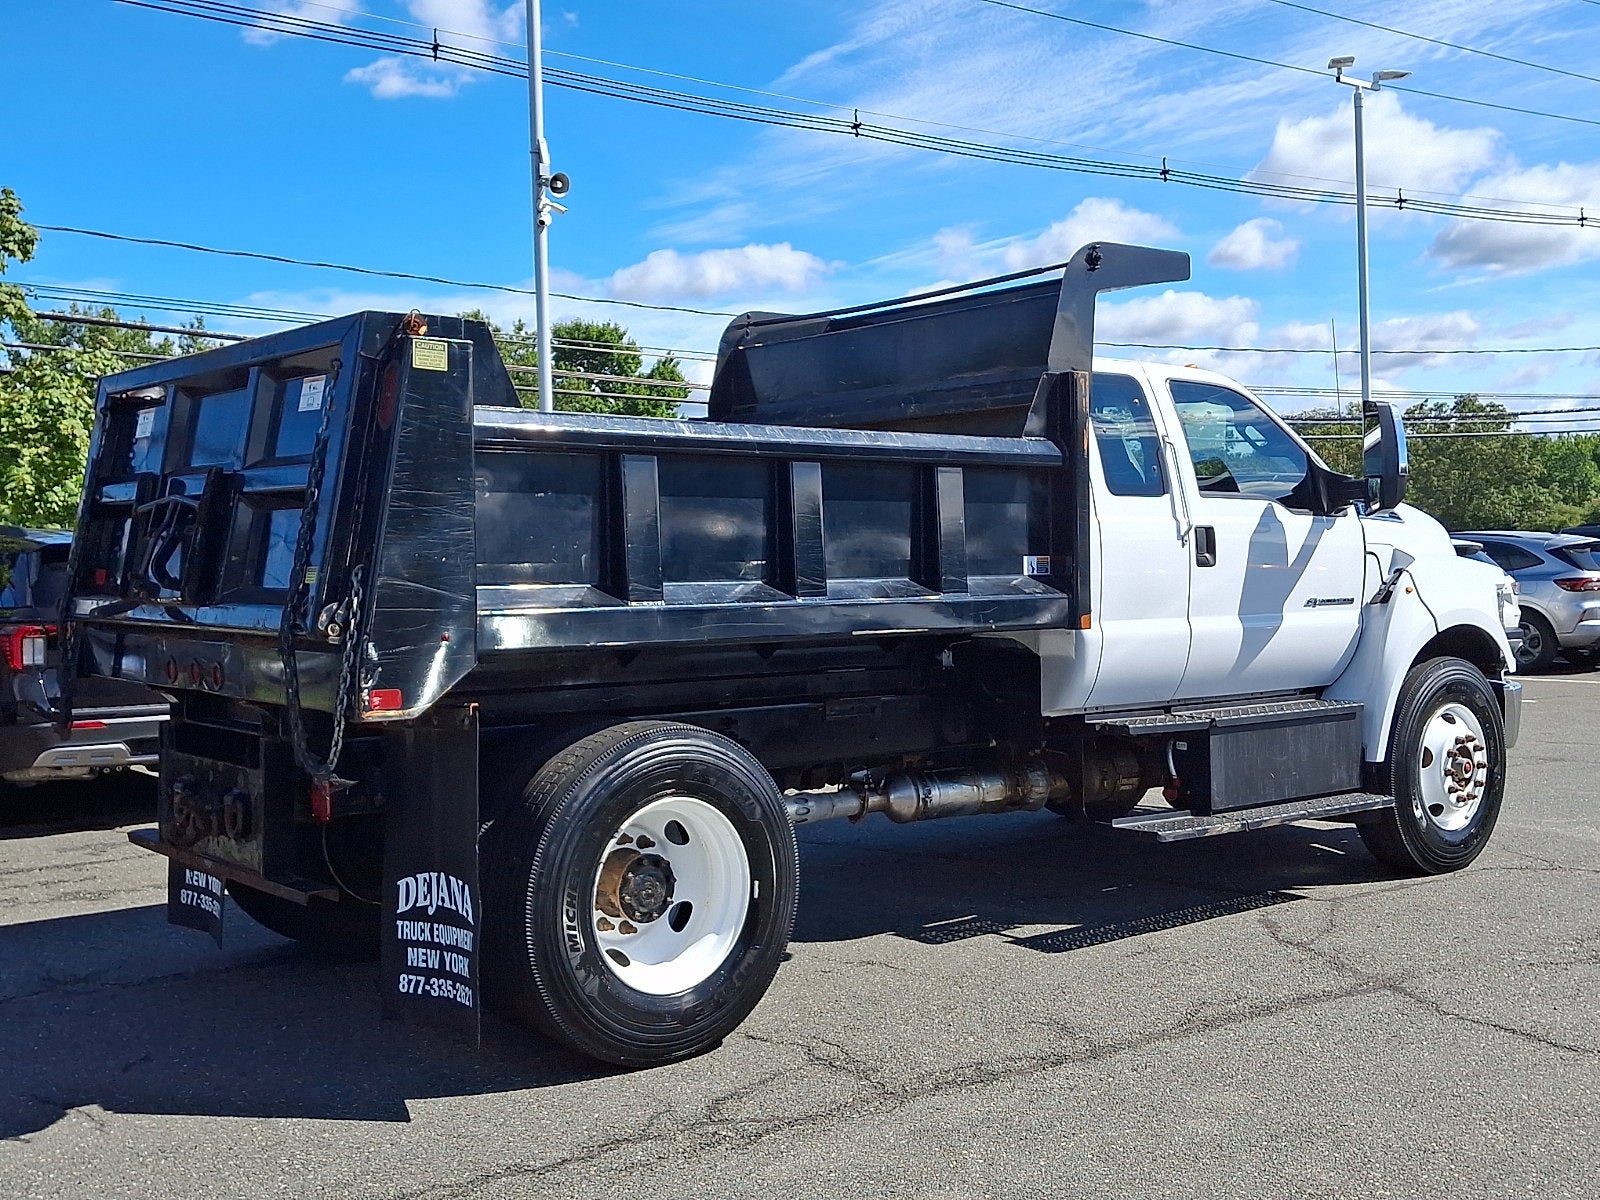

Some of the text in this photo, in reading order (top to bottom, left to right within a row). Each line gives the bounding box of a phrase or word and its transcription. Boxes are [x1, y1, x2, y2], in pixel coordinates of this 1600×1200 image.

[416, 342, 444, 350] CAUTION
[185, 869, 206, 888] NEW
[396, 871, 475, 925] DEJANA
[396, 919, 474, 953] TRUCK EQUIPMENT
[407, 946, 471, 979] NEW YORK
[399, 973, 473, 1008] 877-335-2621
